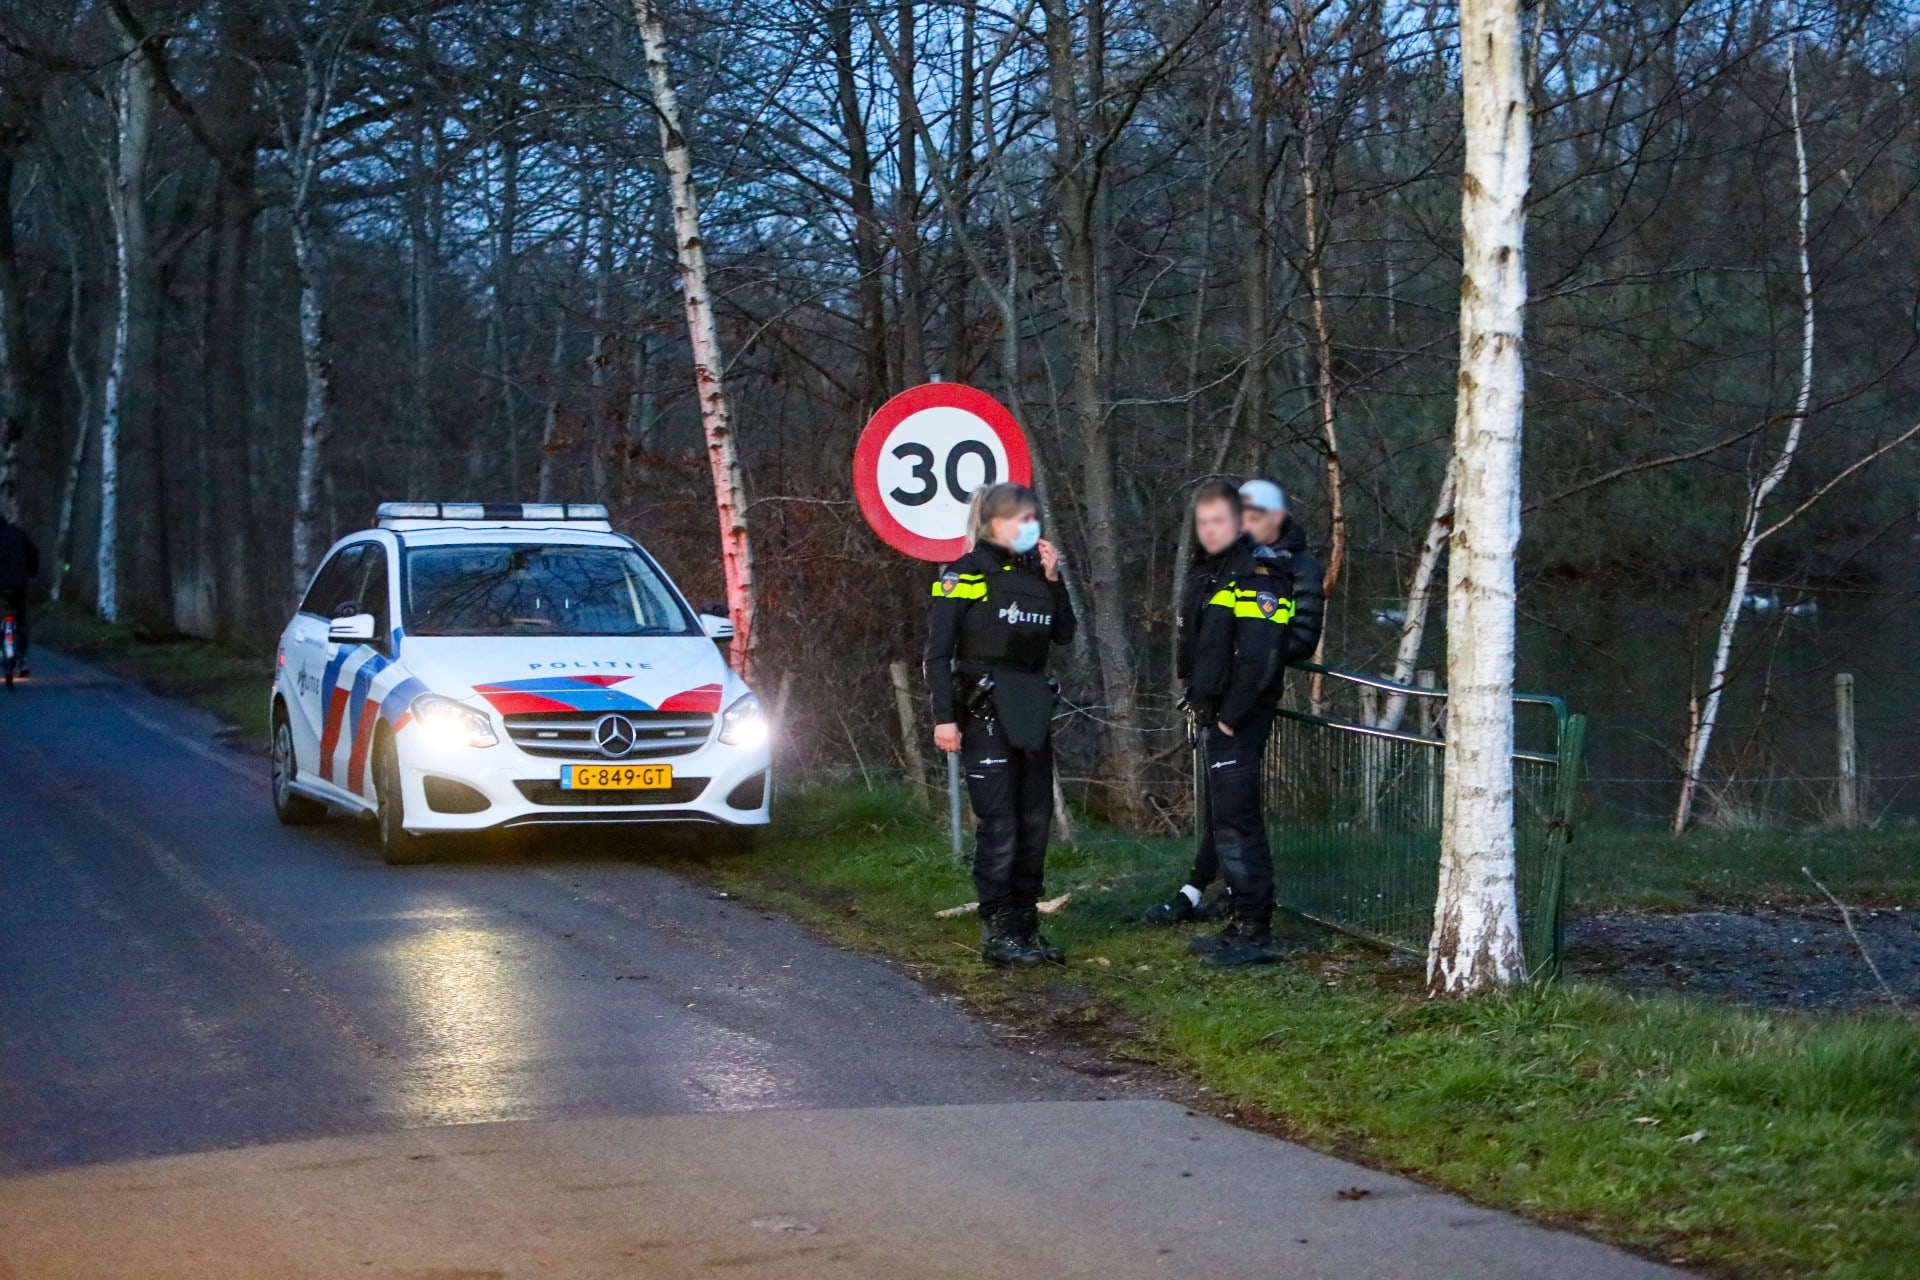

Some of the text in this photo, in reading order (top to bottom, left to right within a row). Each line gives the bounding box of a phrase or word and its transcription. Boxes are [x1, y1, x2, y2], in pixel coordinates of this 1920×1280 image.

[889, 439, 997, 507] 30
[998, 602, 1052, 625] POLITIE
[528, 661, 655, 670] POLITIE
[578, 768, 665, 786] G-849-GT
